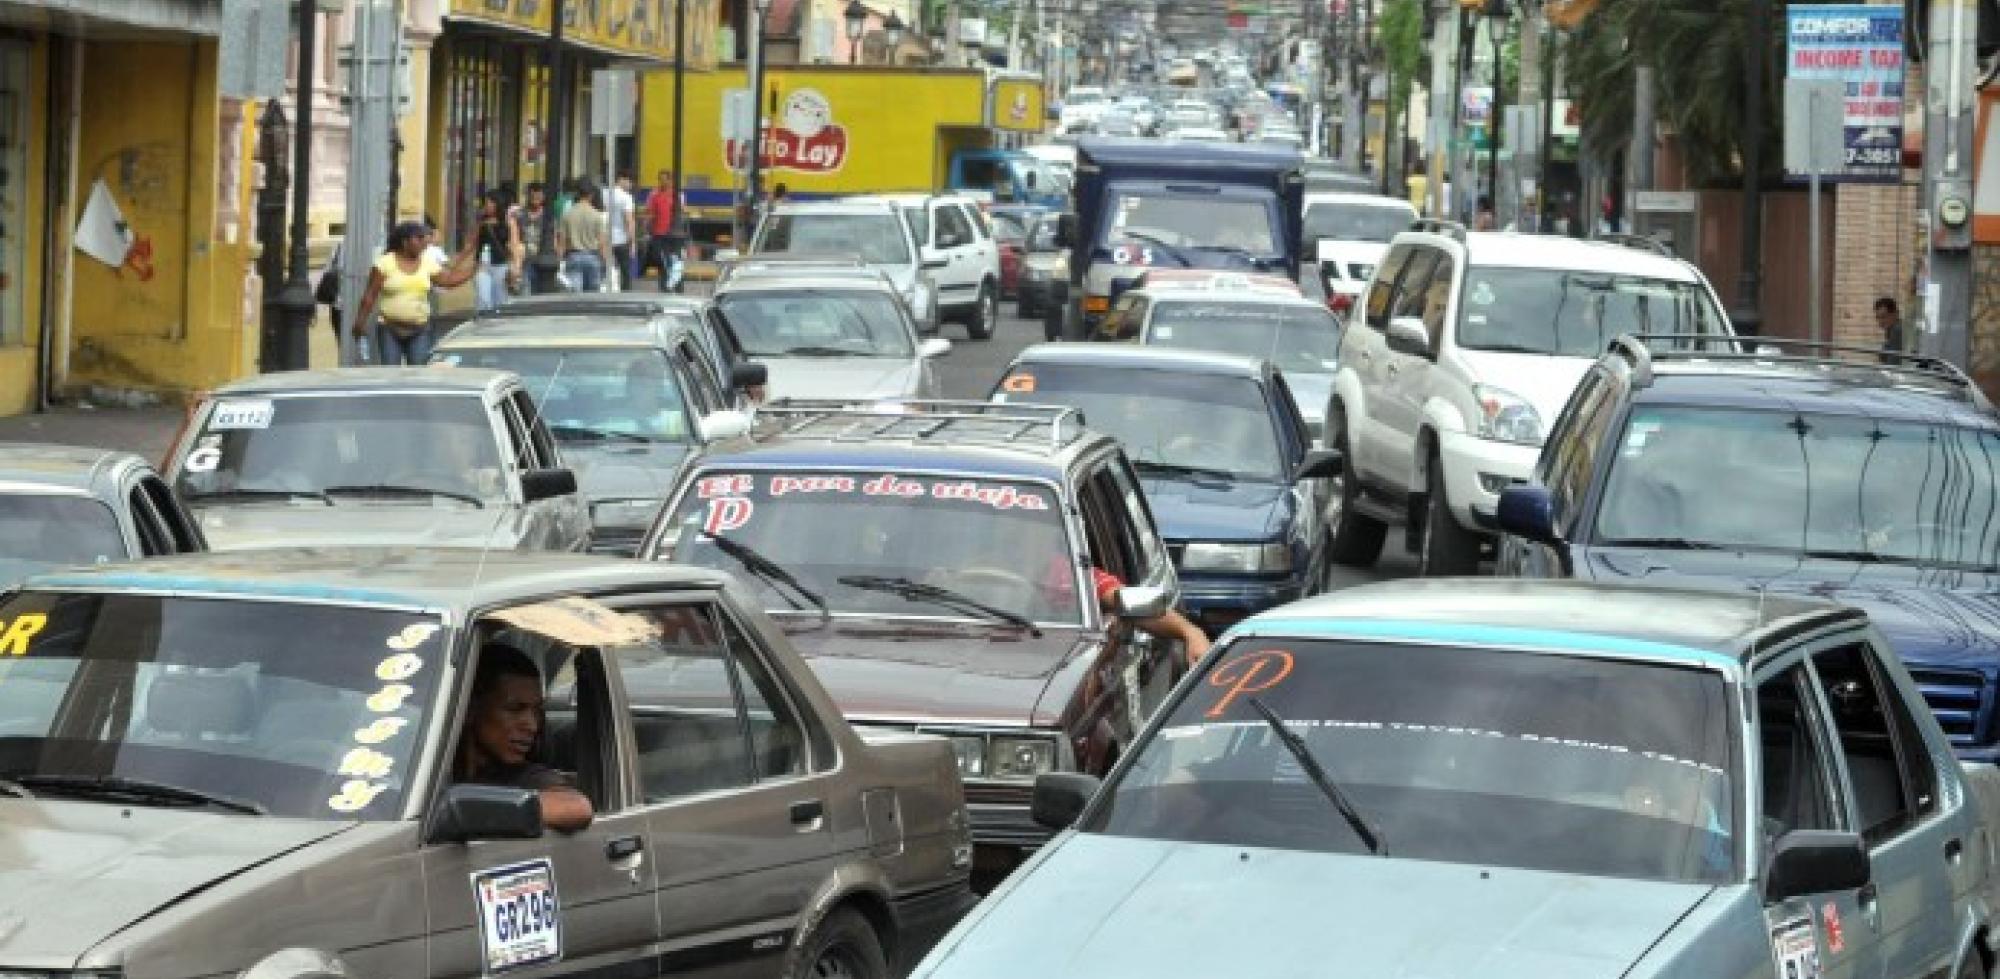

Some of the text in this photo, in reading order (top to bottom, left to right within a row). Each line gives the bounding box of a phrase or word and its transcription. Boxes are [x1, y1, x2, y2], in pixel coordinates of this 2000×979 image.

[1795, 49, 1862, 69] INCOME
[797, 136, 837, 167] Lay
[187, 447, 222, 473] G
[863, 474, 926, 496] de
[0, 612, 47, 655] R
[1204, 650, 1295, 718] P
[495, 889, 554, 942] GR296
